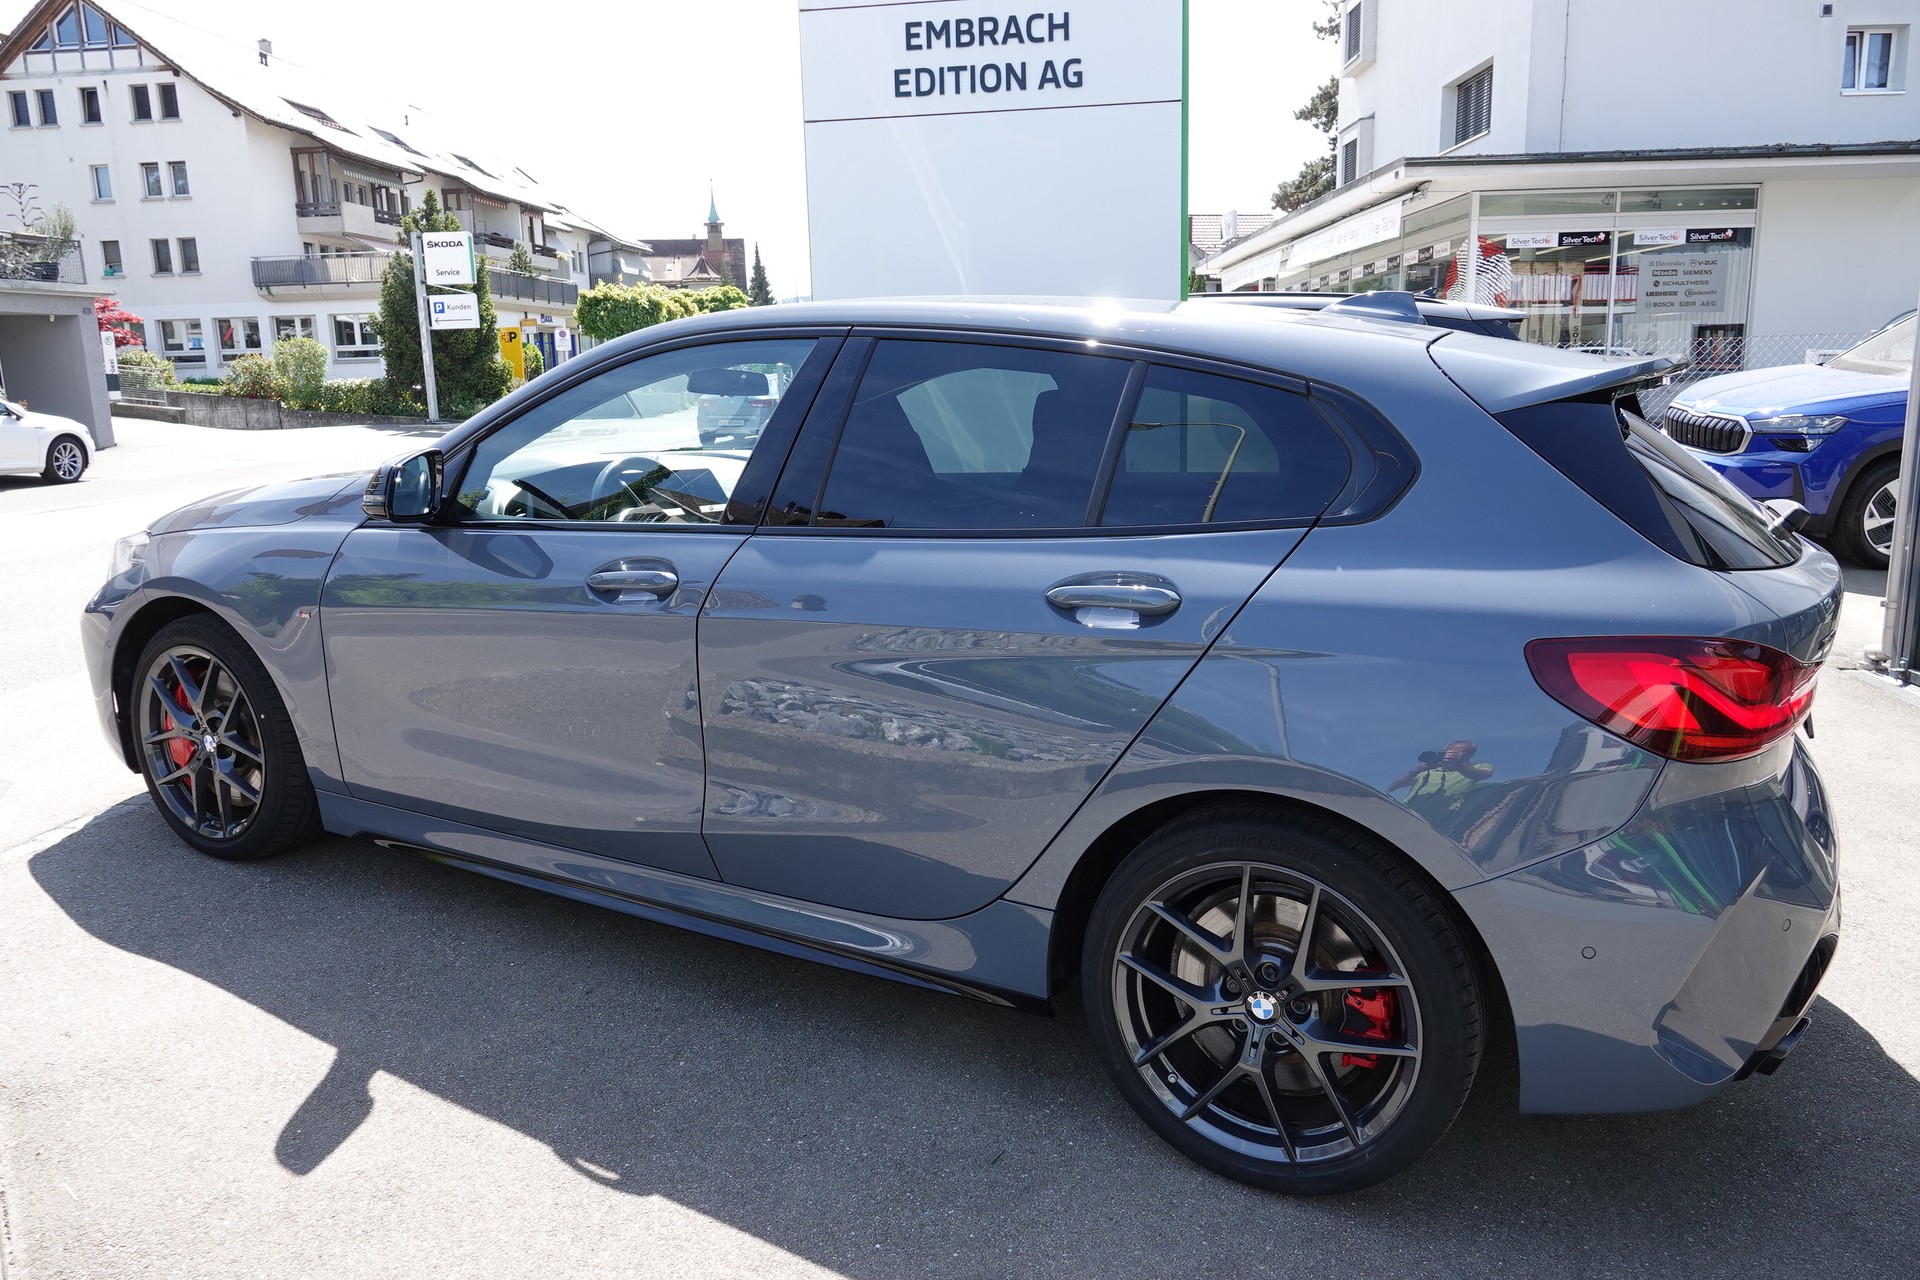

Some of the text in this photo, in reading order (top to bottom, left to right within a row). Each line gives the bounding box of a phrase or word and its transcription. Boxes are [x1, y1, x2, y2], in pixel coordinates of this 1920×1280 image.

[905, 12, 1070, 51] EMBRACH
[894, 58, 1083, 98] EDITION AG
[1562, 236, 1599, 244] SilverTech
[1690, 232, 1727, 240] SilverTech
[426, 239, 464, 249] ŠKODA
[435, 268, 461, 277] Service
[446, 303, 472, 311] Kunden
[1204, 835, 1323, 863] BRIDGESTONE
[1247, 991, 1277, 1004] BMW
